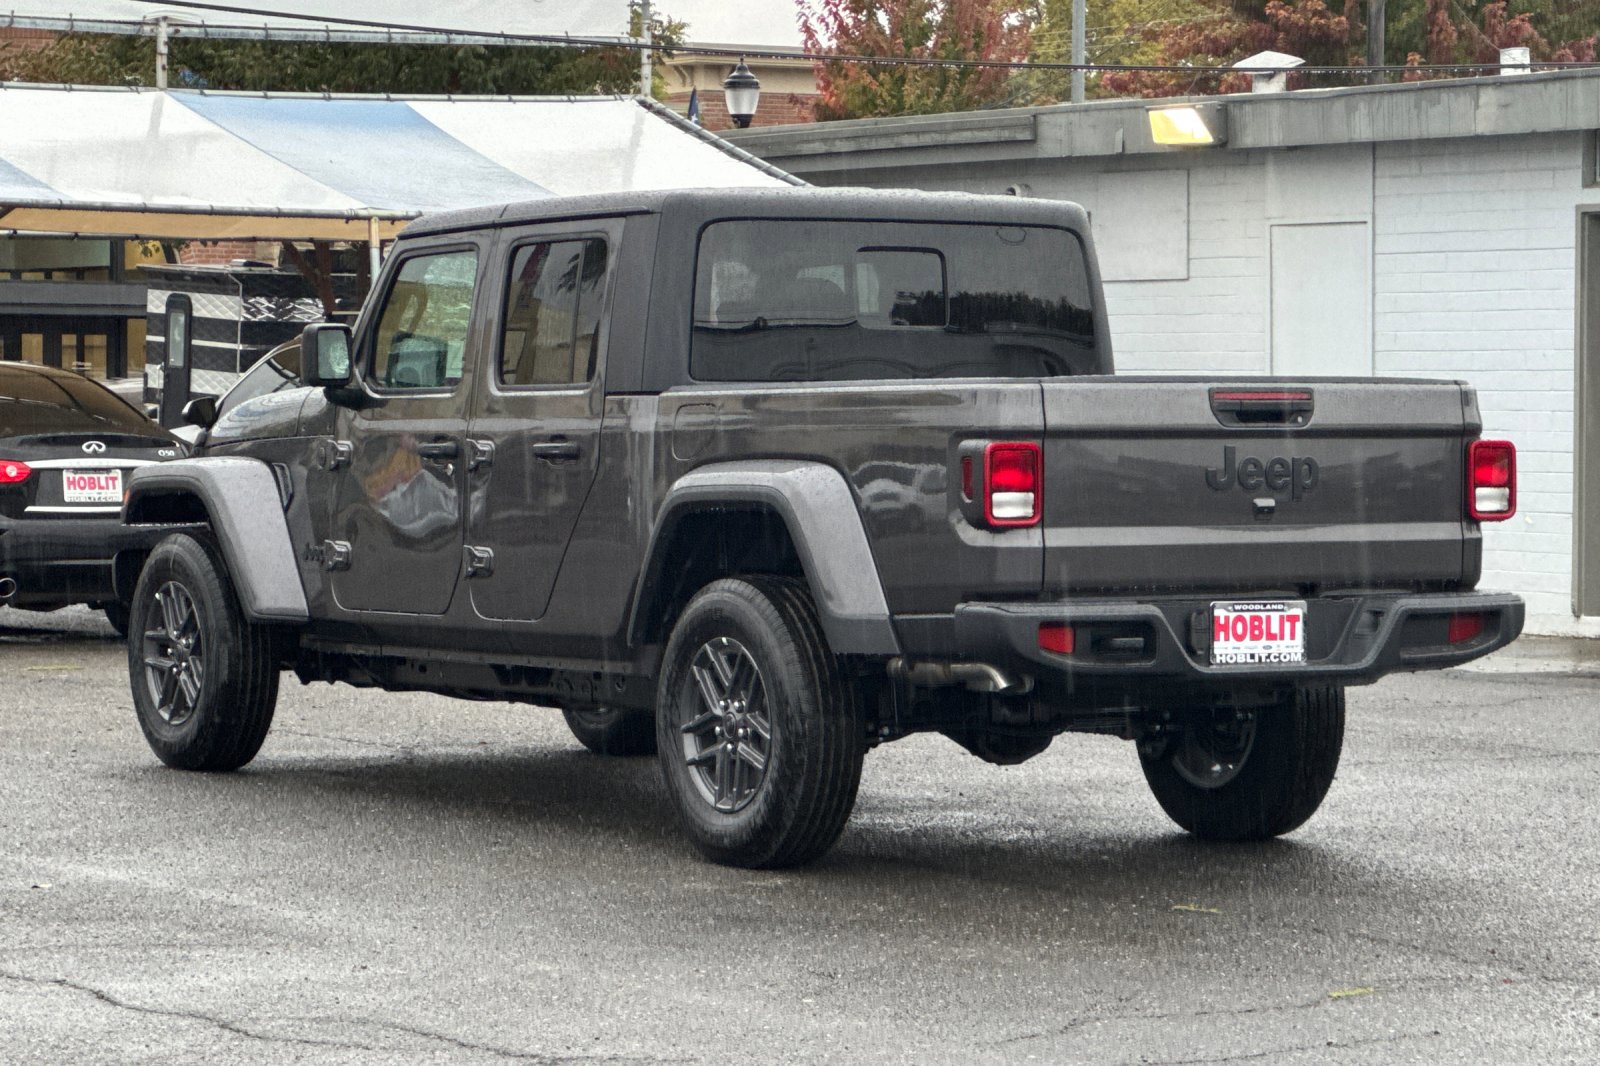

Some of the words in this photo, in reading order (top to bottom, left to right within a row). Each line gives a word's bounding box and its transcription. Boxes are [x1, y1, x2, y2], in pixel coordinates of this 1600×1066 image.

[66, 475, 118, 491] HOBLIT
[1205, 445, 1319, 502] Jeep
[1214, 614, 1300, 642] HOBLIT
[1216, 653, 1302, 664] HOBLIT.COM
